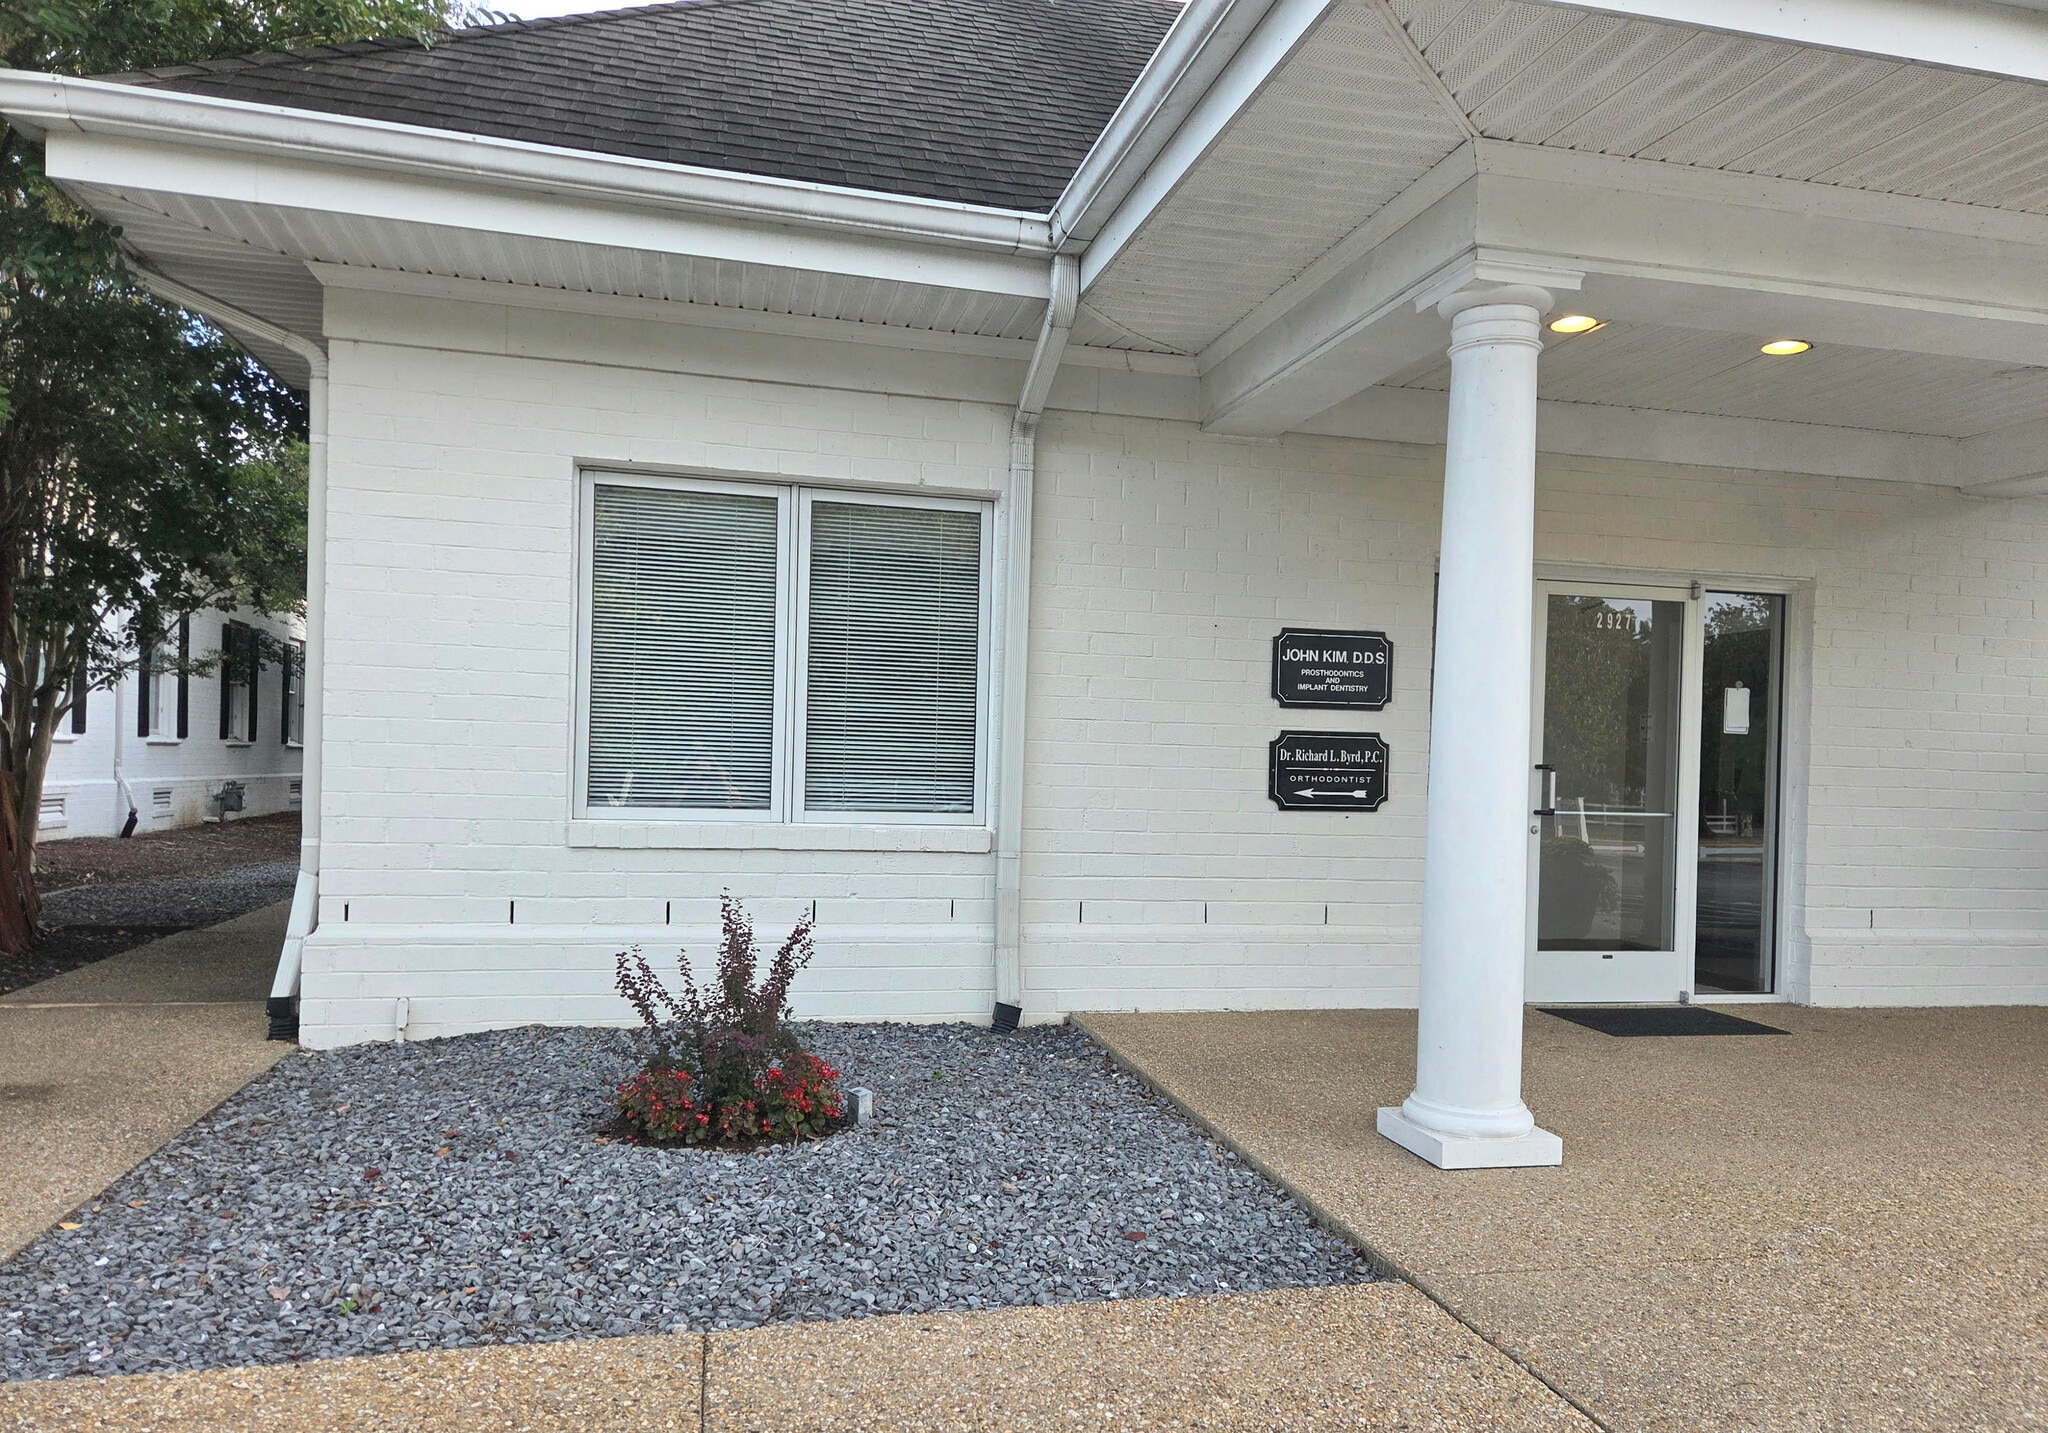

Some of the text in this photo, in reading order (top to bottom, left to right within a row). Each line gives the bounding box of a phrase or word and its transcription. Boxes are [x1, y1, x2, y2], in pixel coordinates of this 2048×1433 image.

[1597, 612, 1630, 630] 2927
[1282, 649, 1319, 662] JOHN
[1301, 669, 1364, 678] PROSTHODONTICS
[1280, 749, 1382, 765] Dr. Richard L. Byrd, P.C.
[1289, 775, 1372, 783] ORTHODONTIST
